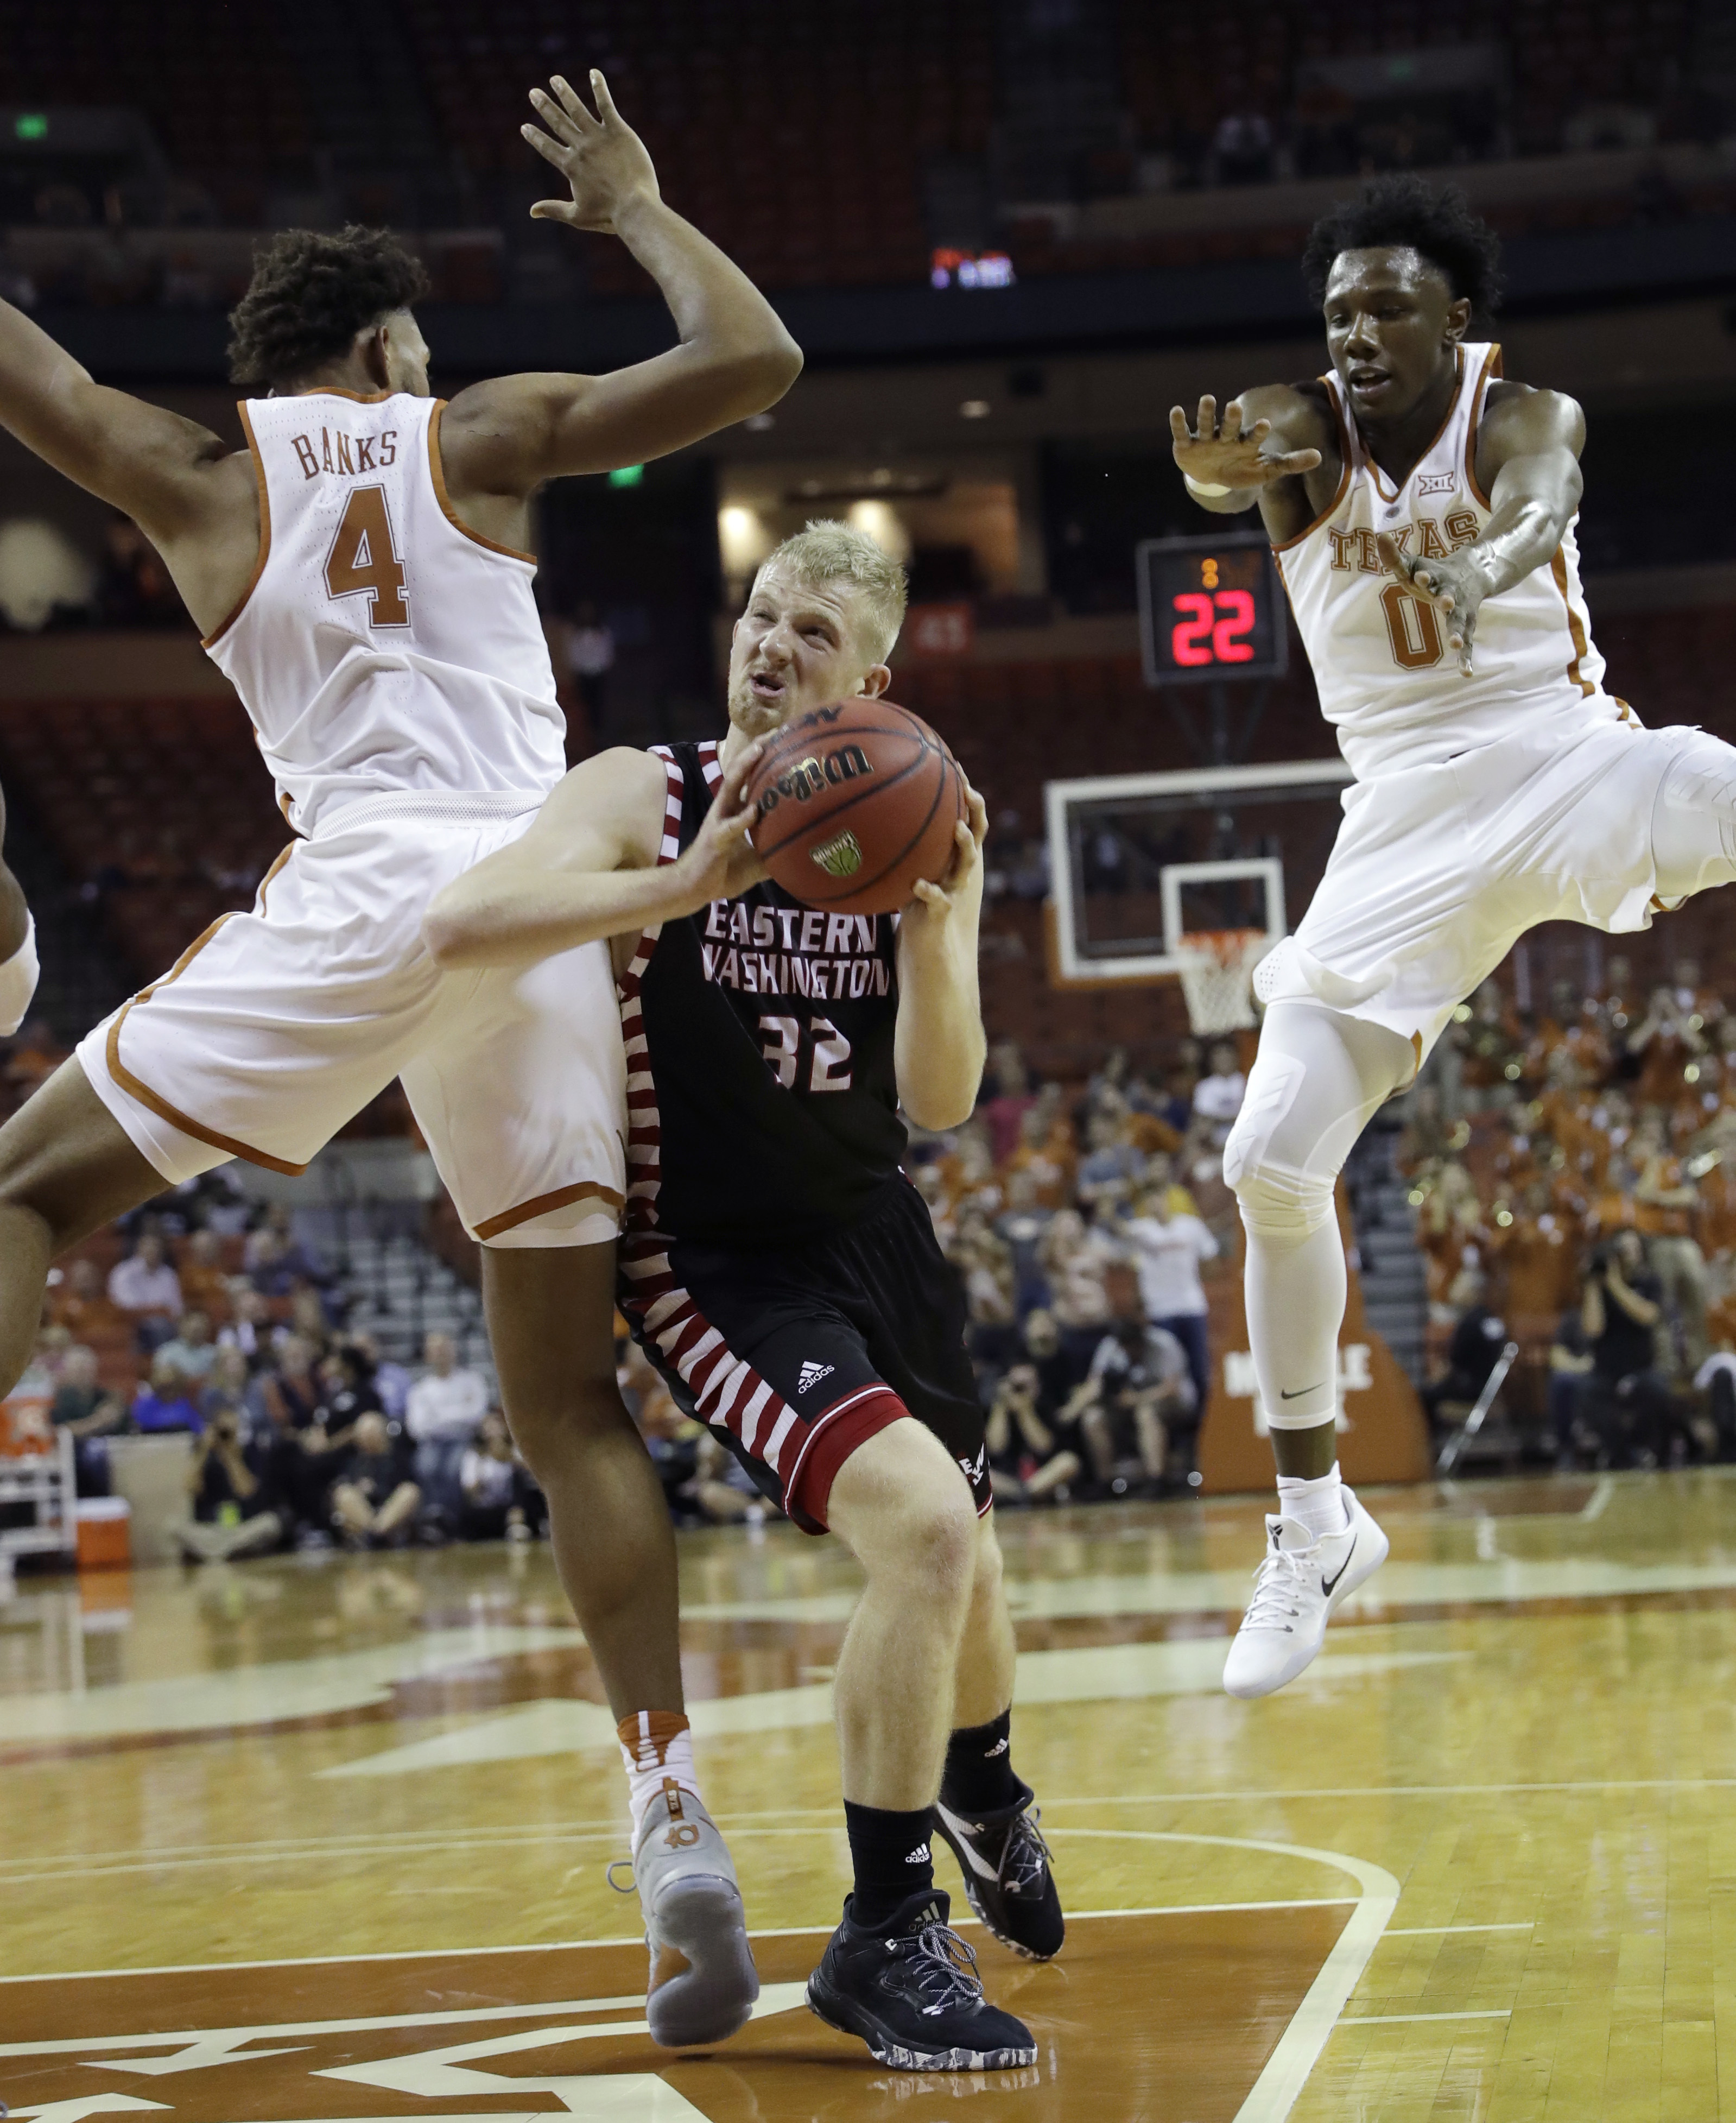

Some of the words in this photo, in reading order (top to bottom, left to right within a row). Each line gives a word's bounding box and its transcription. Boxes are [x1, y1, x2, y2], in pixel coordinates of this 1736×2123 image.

[291, 426, 397, 480] BANKS
[322, 483, 411, 629] 4
[1171, 589, 1256, 667] 22
[1379, 582, 1444, 671] 0
[705, 898, 877, 953] EASTERN
[759, 1015, 852, 1092] 32
[798, 1364, 835, 1394] adidas
[905, 1852, 930, 1863] adidas
